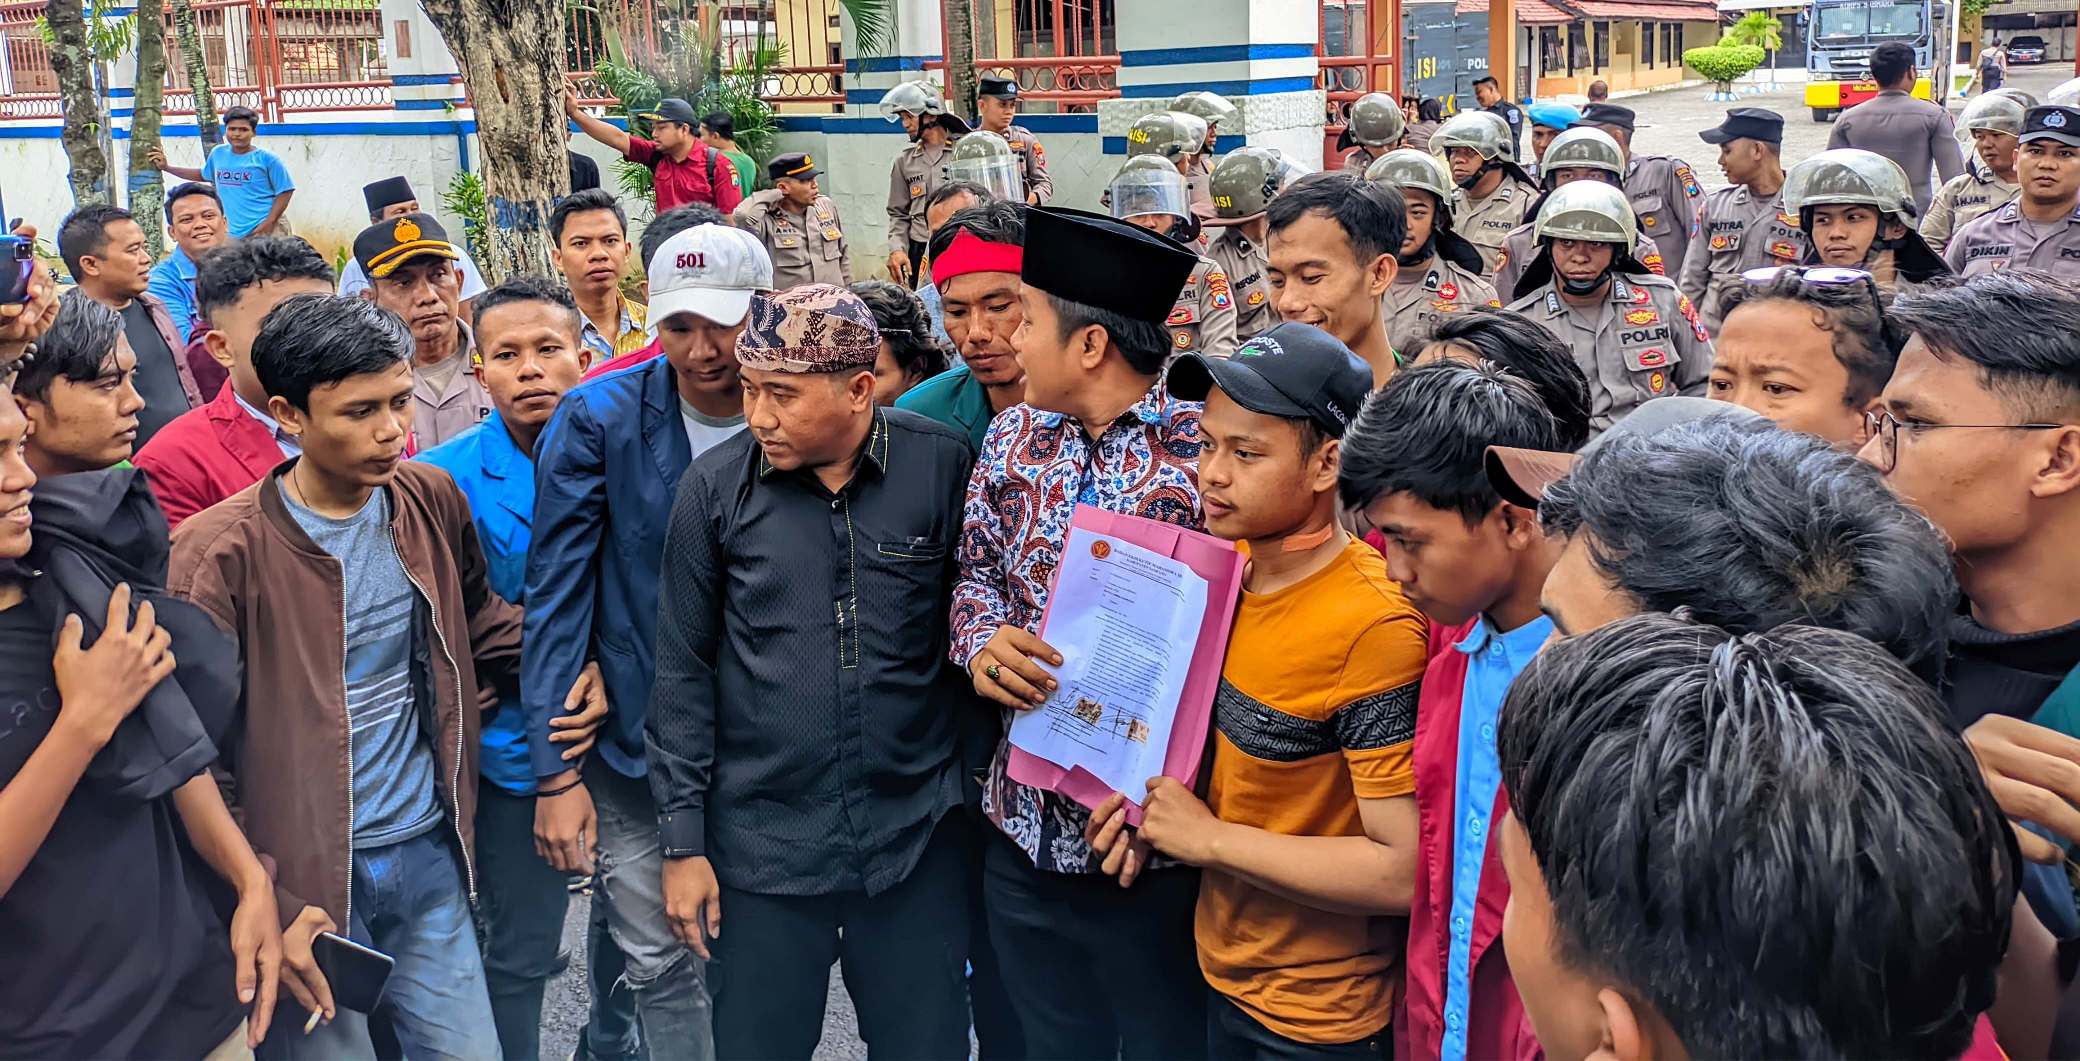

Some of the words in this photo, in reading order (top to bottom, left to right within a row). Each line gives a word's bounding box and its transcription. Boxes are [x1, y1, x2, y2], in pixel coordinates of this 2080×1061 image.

[1481, 220, 1511, 230] POLRI
[1710, 220, 1744, 232] PUTRA
[1970, 246, 2010, 258] DIKIN
[676, 252, 706, 269] 501
[1620, 326, 1669, 345] POLRI
